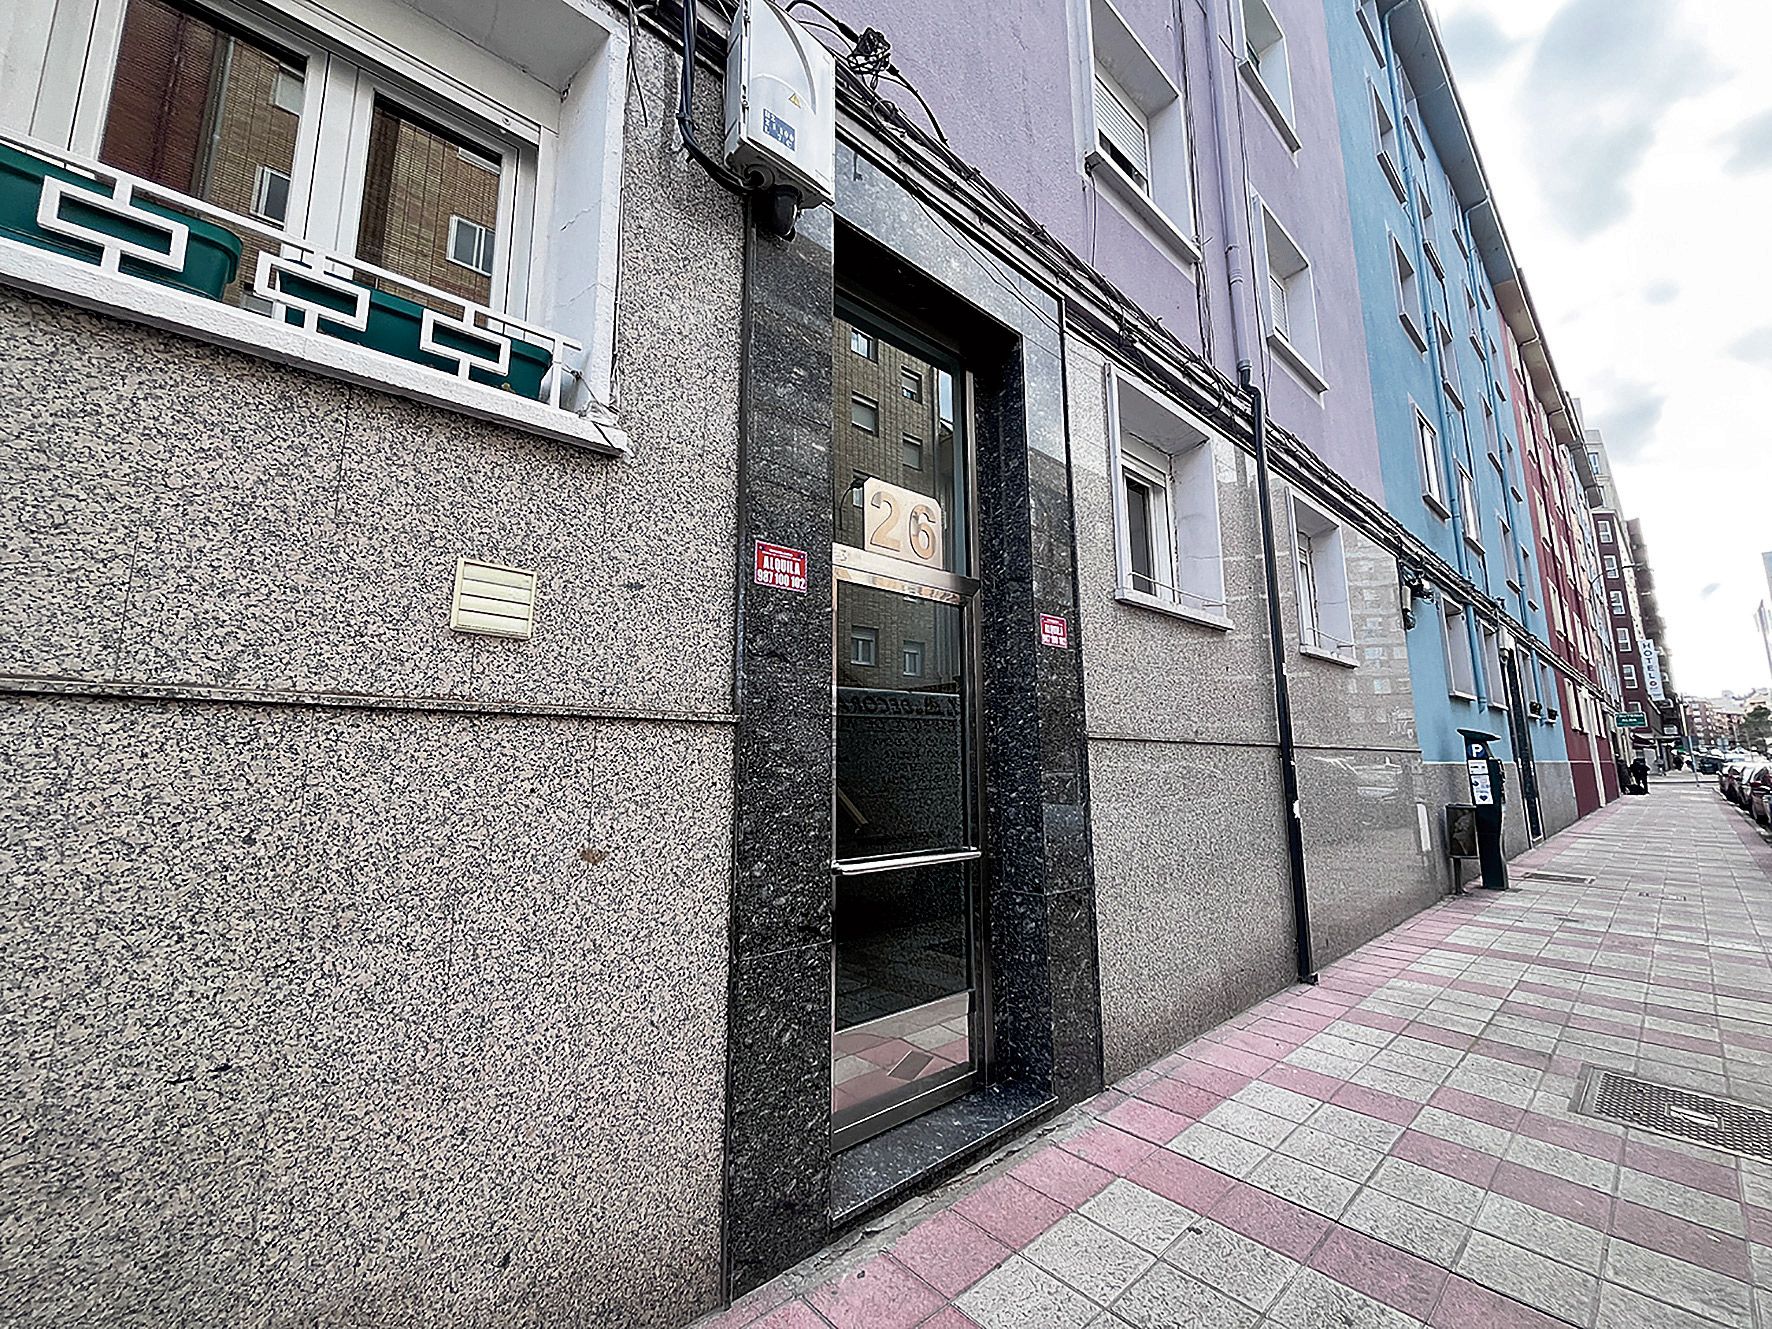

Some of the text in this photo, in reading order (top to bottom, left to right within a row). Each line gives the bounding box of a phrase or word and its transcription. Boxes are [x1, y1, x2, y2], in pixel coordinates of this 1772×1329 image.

[870, 490, 937, 560] 26
[763, 555, 801, 575] ALQUILA
[757, 568, 806, 590] 987 100 102
[1471, 743, 1483, 757] P
